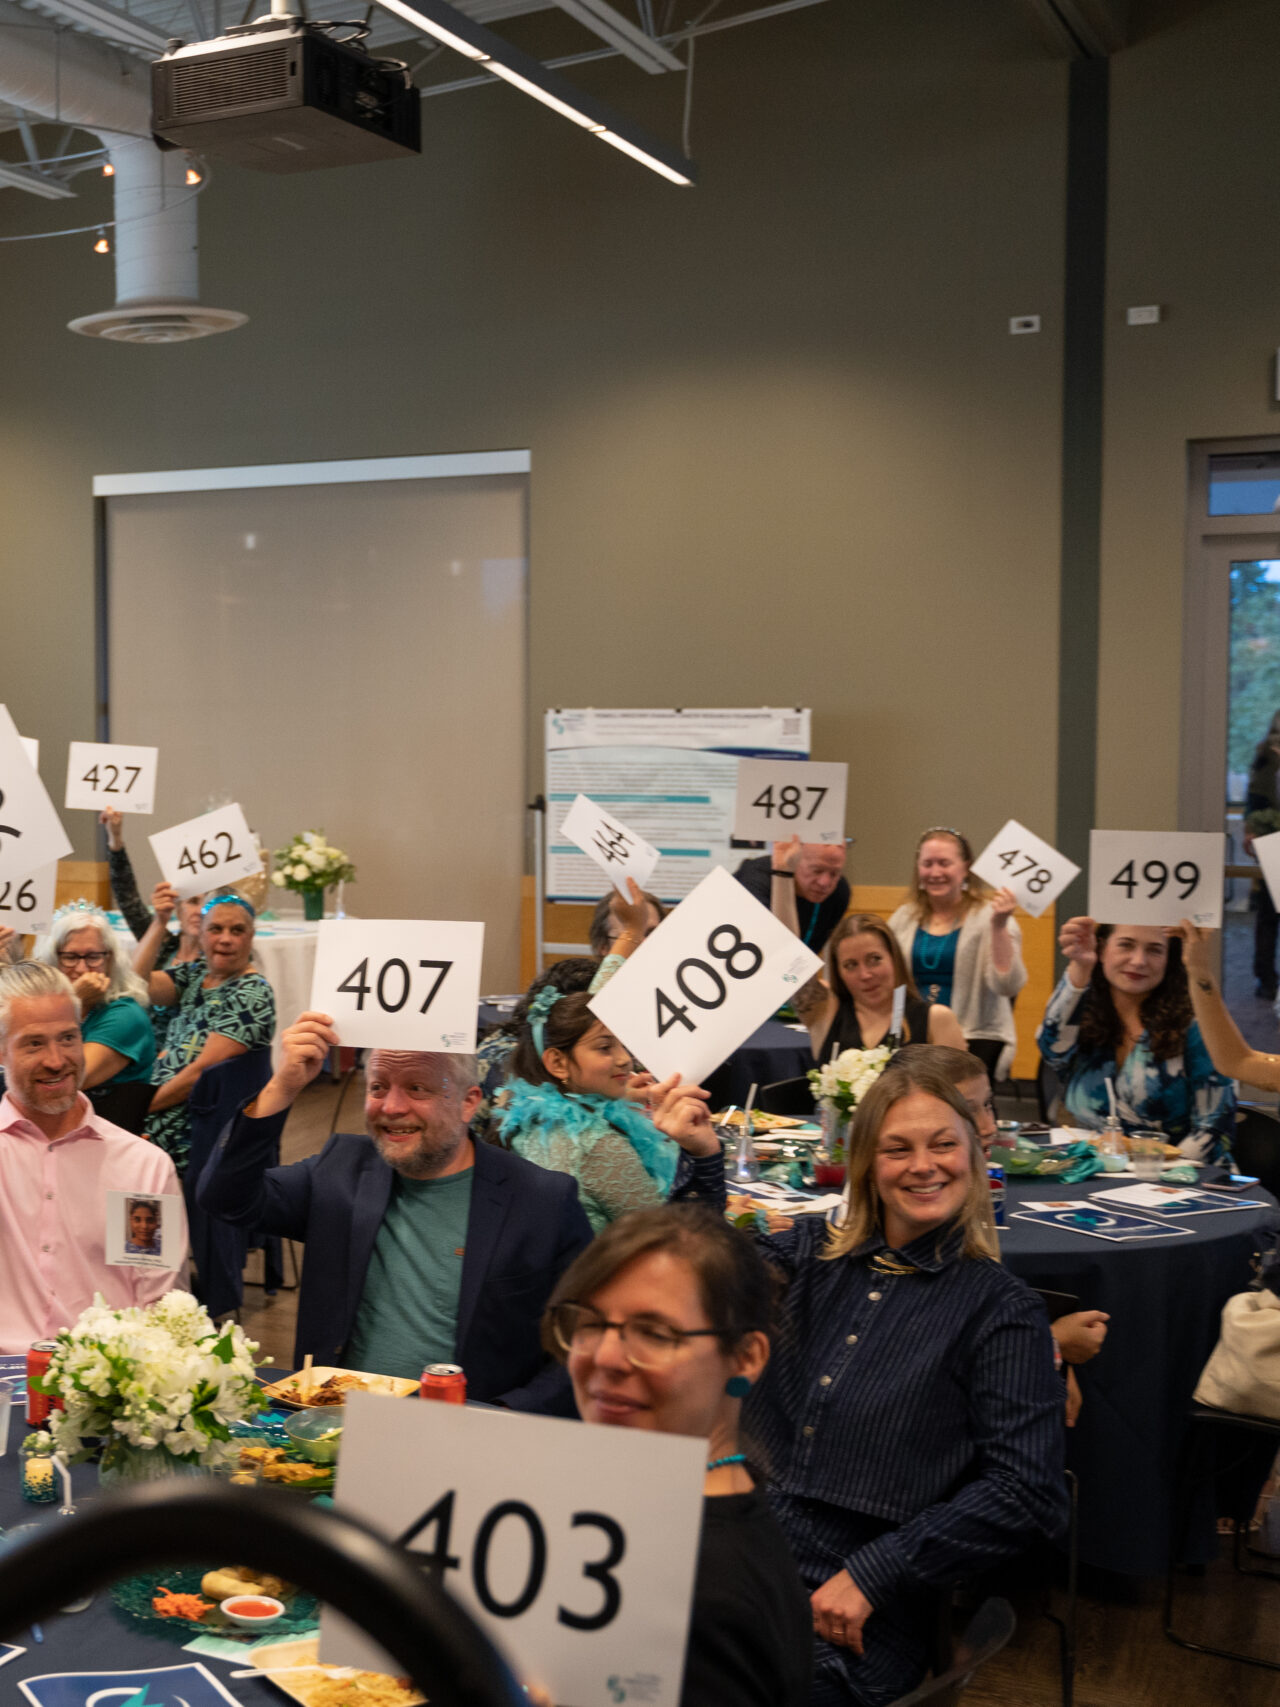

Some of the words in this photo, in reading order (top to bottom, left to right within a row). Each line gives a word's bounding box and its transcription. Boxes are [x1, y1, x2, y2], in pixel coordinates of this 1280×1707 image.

[82, 764, 142, 793] 427
[752, 785, 829, 821] 487
[177, 831, 242, 875] 462
[591, 819, 635, 866] 464
[998, 850, 1052, 894] 478
[1109, 859, 1201, 901] 499
[336, 957, 454, 1015] 407
[655, 923, 764, 1038] 408
[393, 1488, 627, 1632] 403
